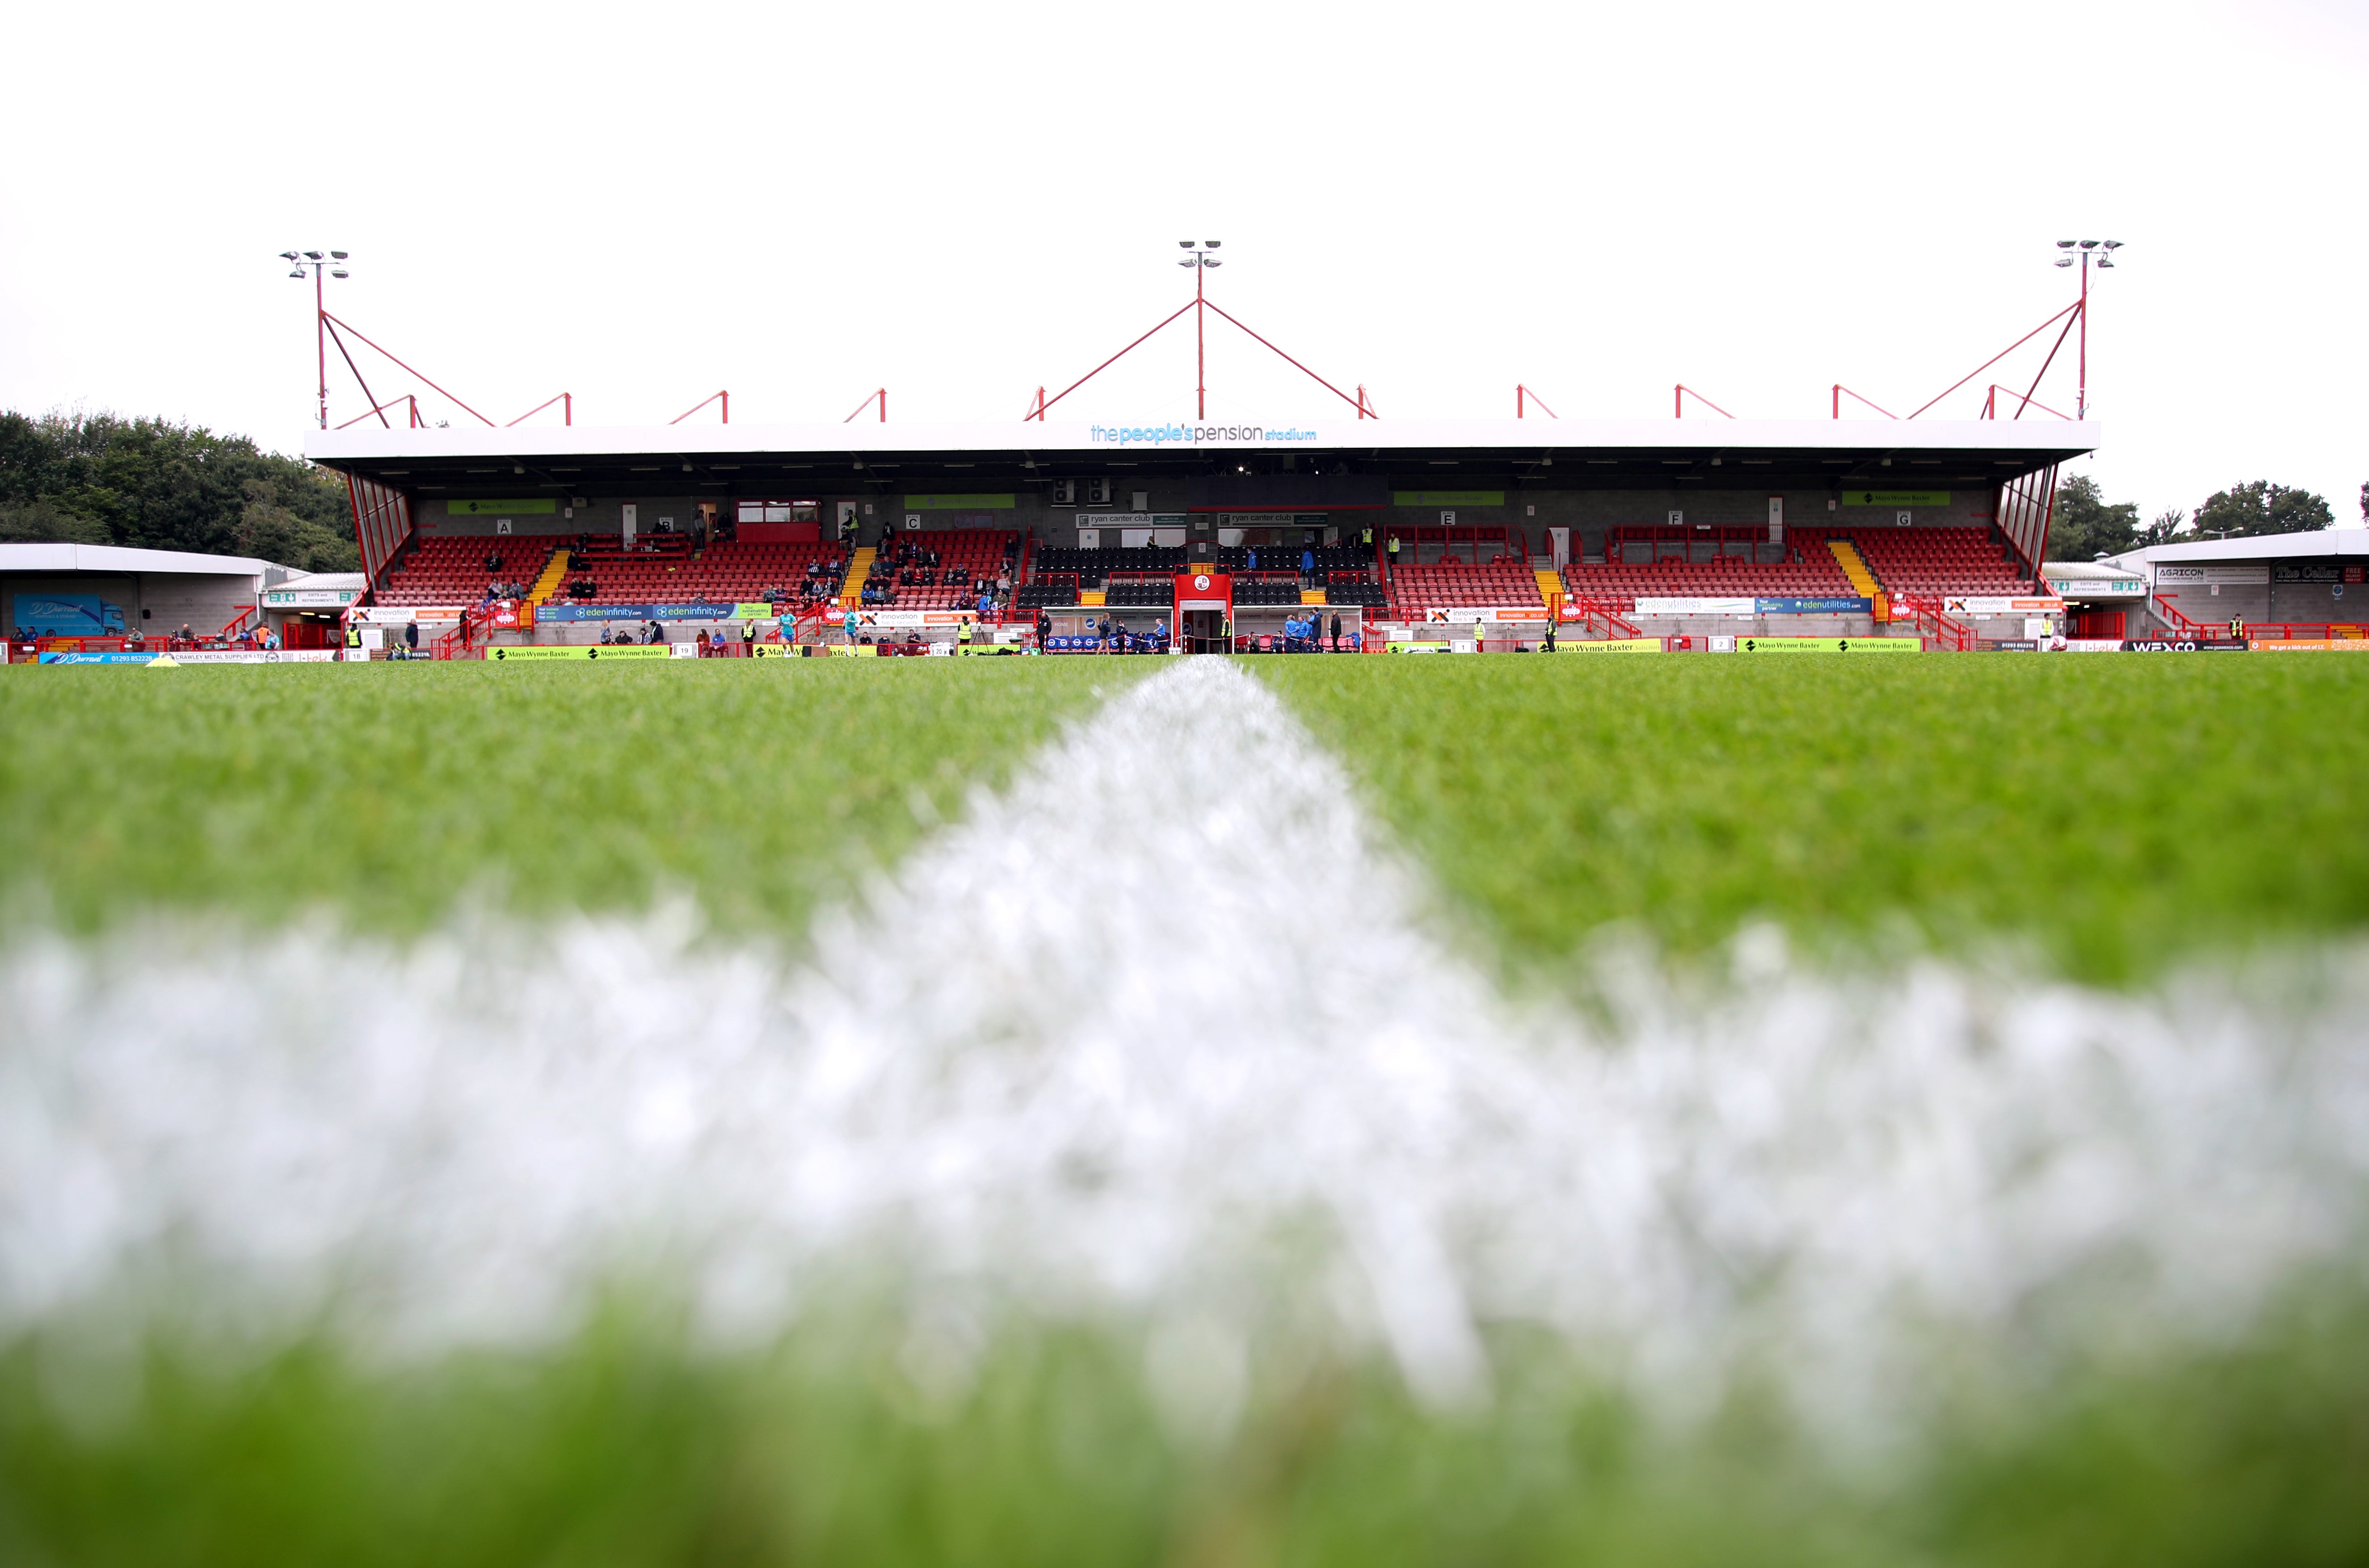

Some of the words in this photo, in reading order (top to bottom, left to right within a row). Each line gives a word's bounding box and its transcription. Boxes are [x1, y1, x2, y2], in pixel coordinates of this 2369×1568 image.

[909, 518, 917, 528] C
[1444, 515, 1452, 524] E
[1672, 515, 1679, 524] F
[1900, 515, 1908, 525] G
[501, 523, 509, 533] A
[662, 521, 670, 531] B
[2276, 566, 2299, 578] The
[2302, 566, 2339, 578] Cellar
[1803, 600, 1860, 609] edenutilities.com
[586, 608, 642, 617] edeninfinity.com
[668, 606, 727, 616] edeninfinity.com
[1758, 642, 1776, 650] Mayo
[1776, 642, 1798, 650] Wynne
[1851, 642, 1868, 650] Mayo
[1869, 642, 1891, 650] Wynne
[2133, 642, 2196, 652] WEXCO
[55, 653, 68, 664] D
[67, 653, 105, 664] Durrant
